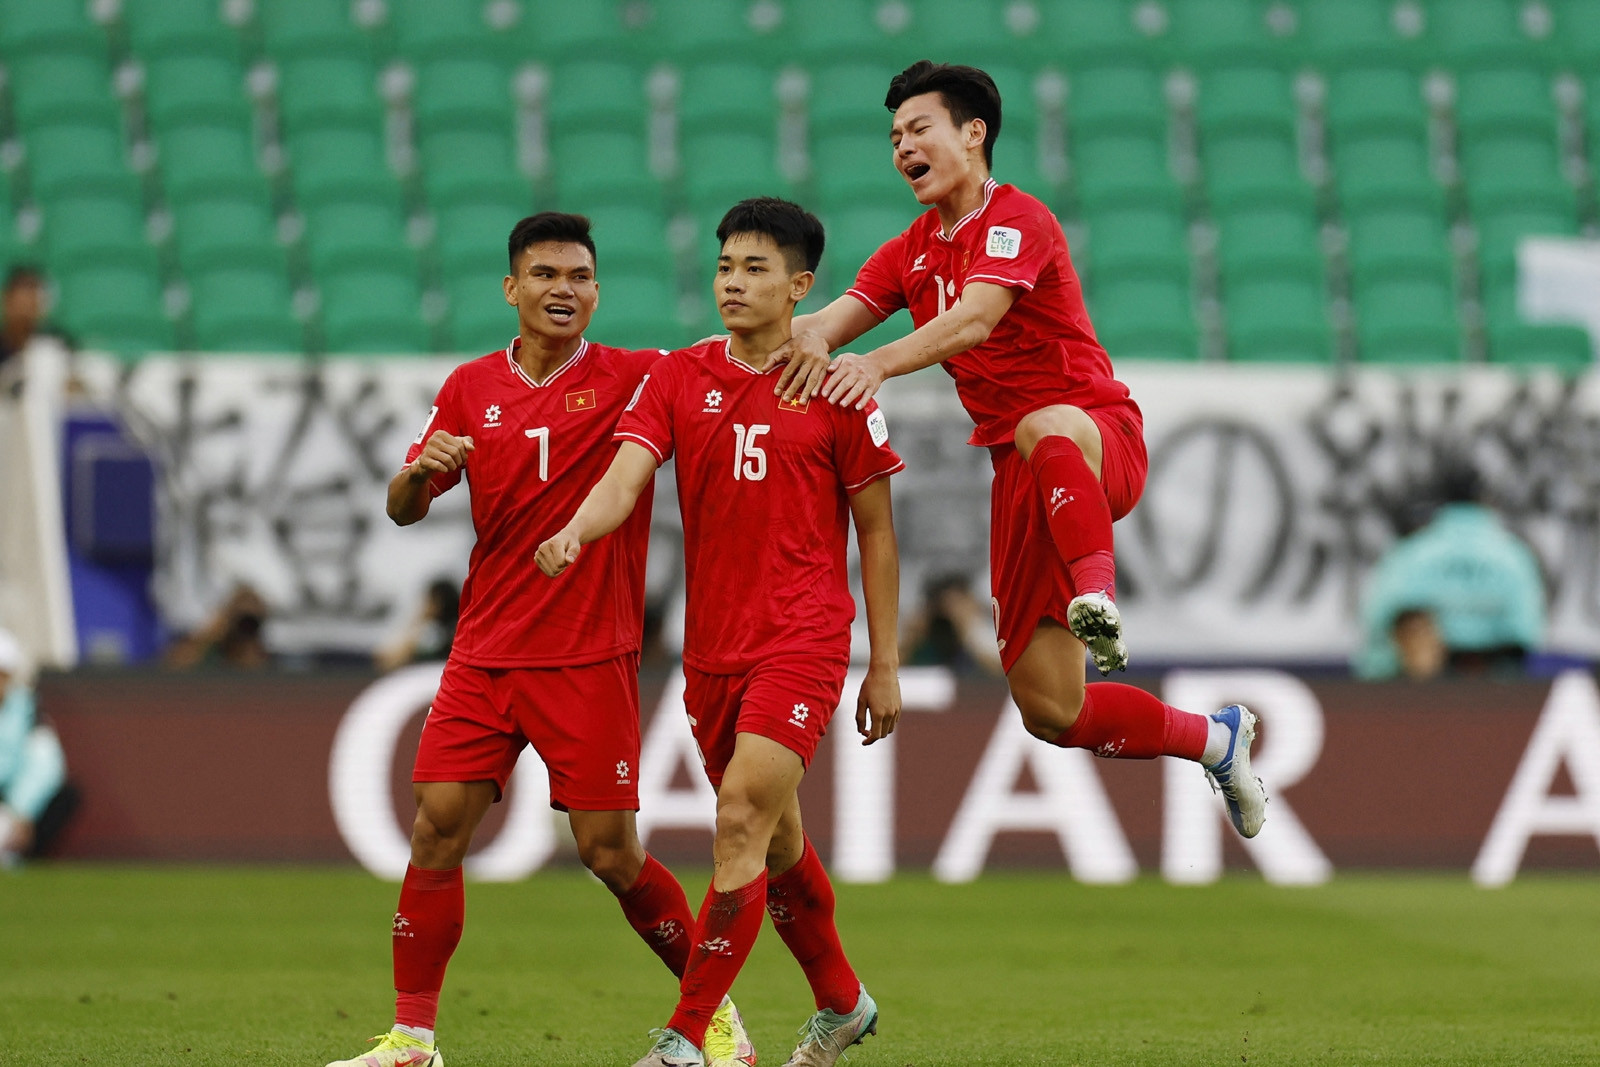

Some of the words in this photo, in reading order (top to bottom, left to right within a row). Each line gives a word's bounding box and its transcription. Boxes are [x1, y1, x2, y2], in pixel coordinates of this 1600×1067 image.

[991, 236, 1015, 247] LIVE
[524, 426, 550, 482] 7
[733, 423, 771, 481] 15
